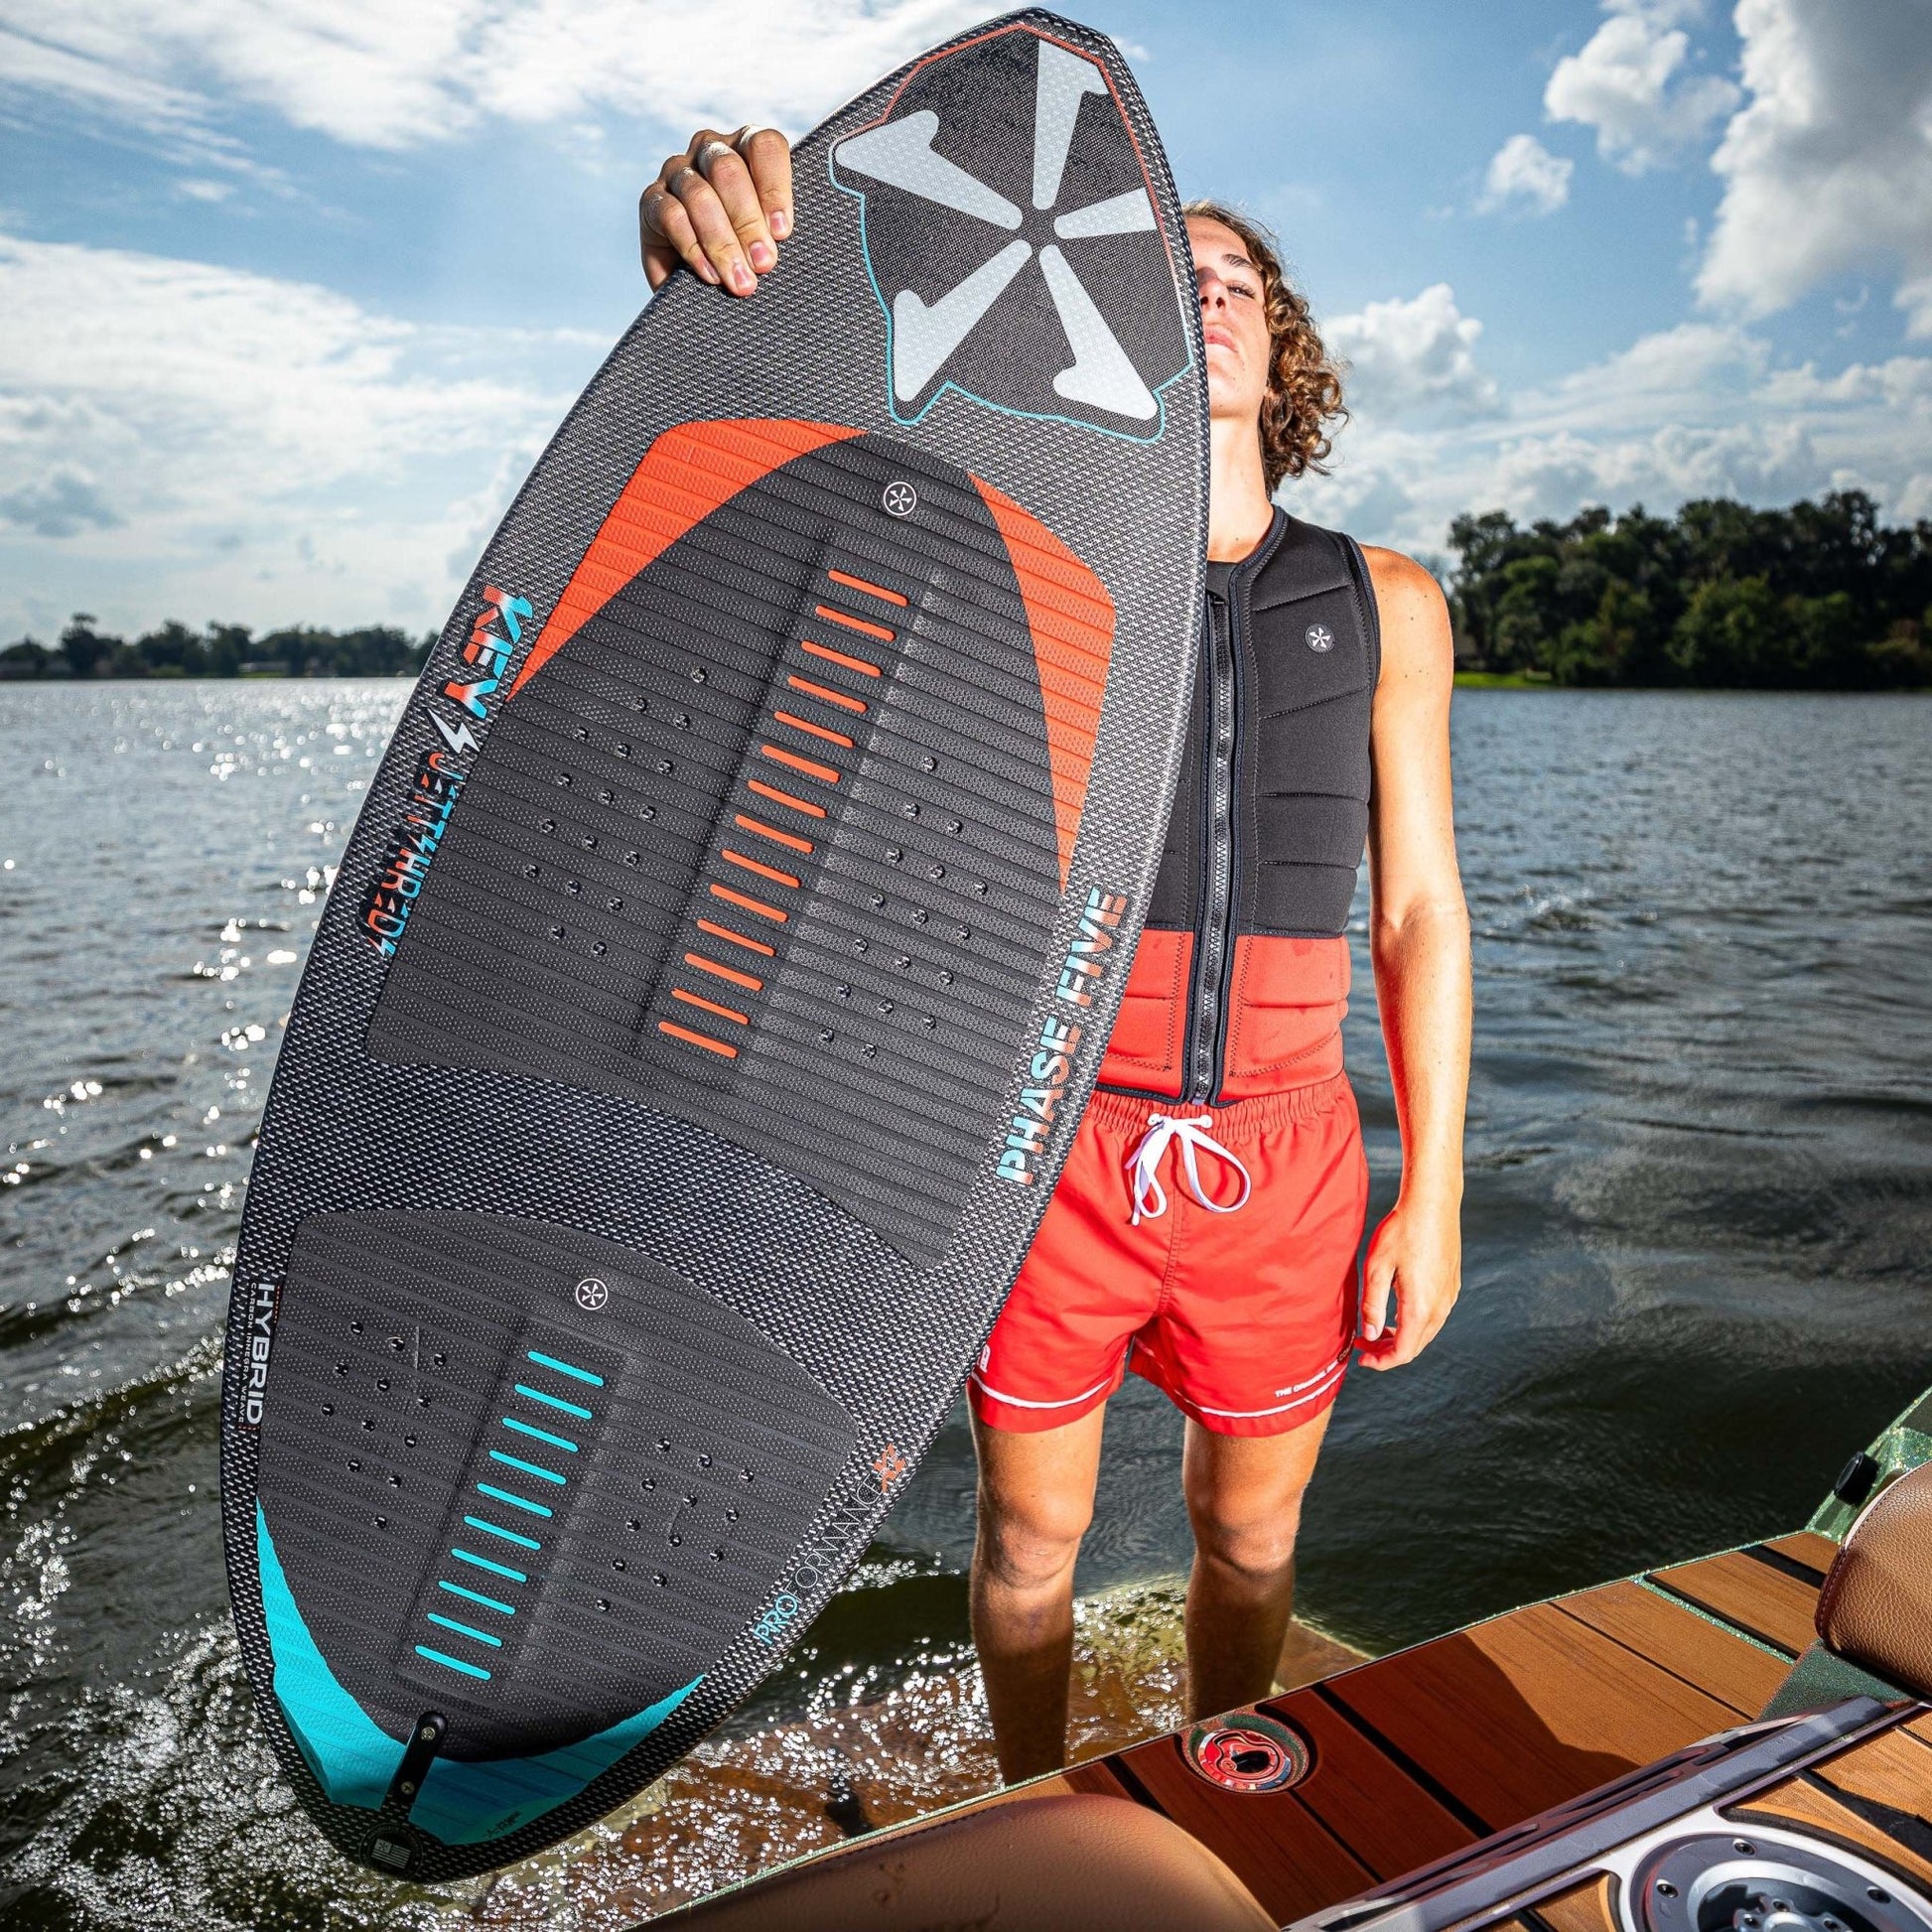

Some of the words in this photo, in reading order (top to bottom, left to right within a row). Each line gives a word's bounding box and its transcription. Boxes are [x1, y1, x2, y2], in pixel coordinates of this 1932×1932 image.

[444, 585, 533, 719] KEY
[995, 1015, 1082, 1186] PHASE
[1055, 886, 1128, 1009] FIVE
[247, 1282, 257, 1329] CARBON
[246, 1283, 276, 1426] HYBRID
[1275, 1387, 1293, 1398] THE
[238, 1385, 248, 1424] WEAVE
